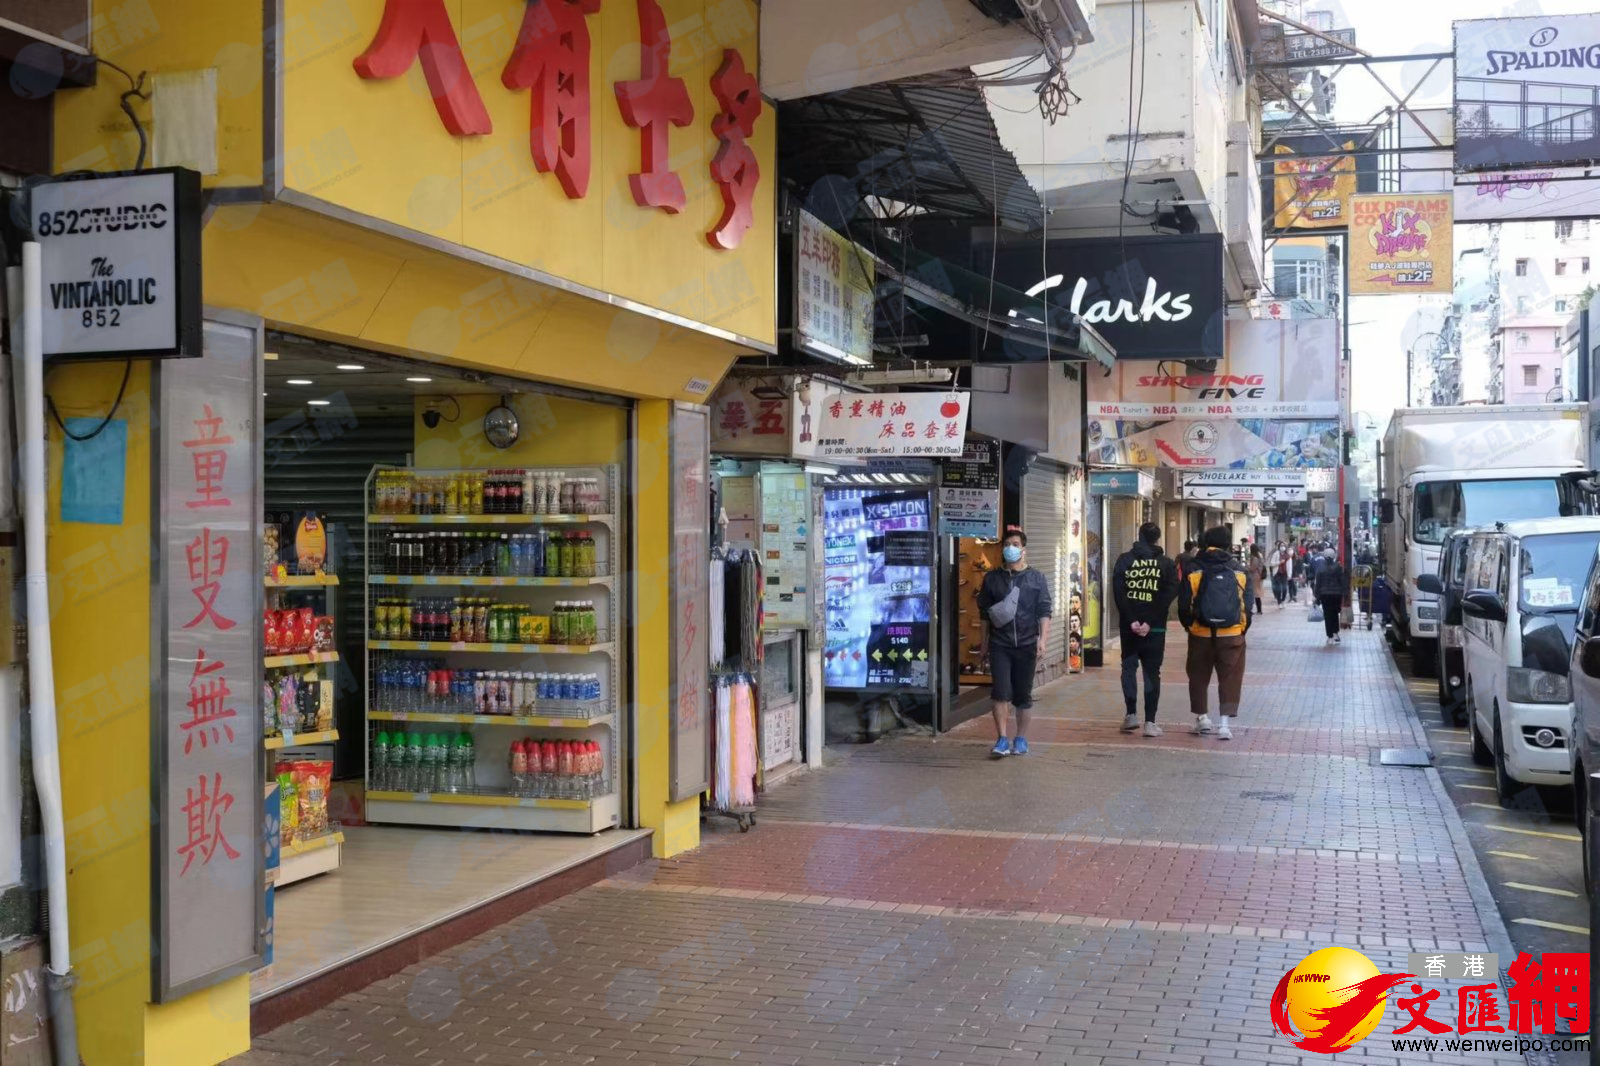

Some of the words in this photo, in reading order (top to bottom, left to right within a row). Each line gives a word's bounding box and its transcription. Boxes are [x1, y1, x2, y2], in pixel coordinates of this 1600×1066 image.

[1486, 46, 1600, 76] SPALDING
[1354, 201, 1380, 214] KIX
[1384, 199, 1449, 213] DREAMS
[91, 257, 114, 278] The
[50, 277, 156, 309] VINTAHOLIC
[82, 308, 120, 328] 852
[1136, 374, 1265, 387] SHOOTING
[1198, 387, 1266, 399] FIVE
[829, 399, 906, 419] 香薰精油
[1099, 405, 1121, 415] NBA
[1123, 406, 1143, 414] T-shirt
[1152, 405, 1178, 415] NBA
[1207, 405, 1233, 415] NBA
[878, 420, 960, 440] 床品套裝
[1197, 472, 1248, 481] SHOELAXE
[826, 536, 854, 548] YONEX
[1131, 559, 1158, 568] ANTI
[1125, 567, 1161, 578] SOCIAL
[1126, 590, 1153, 602] CLUB
[176, 402, 242, 878] 童叟無欺
